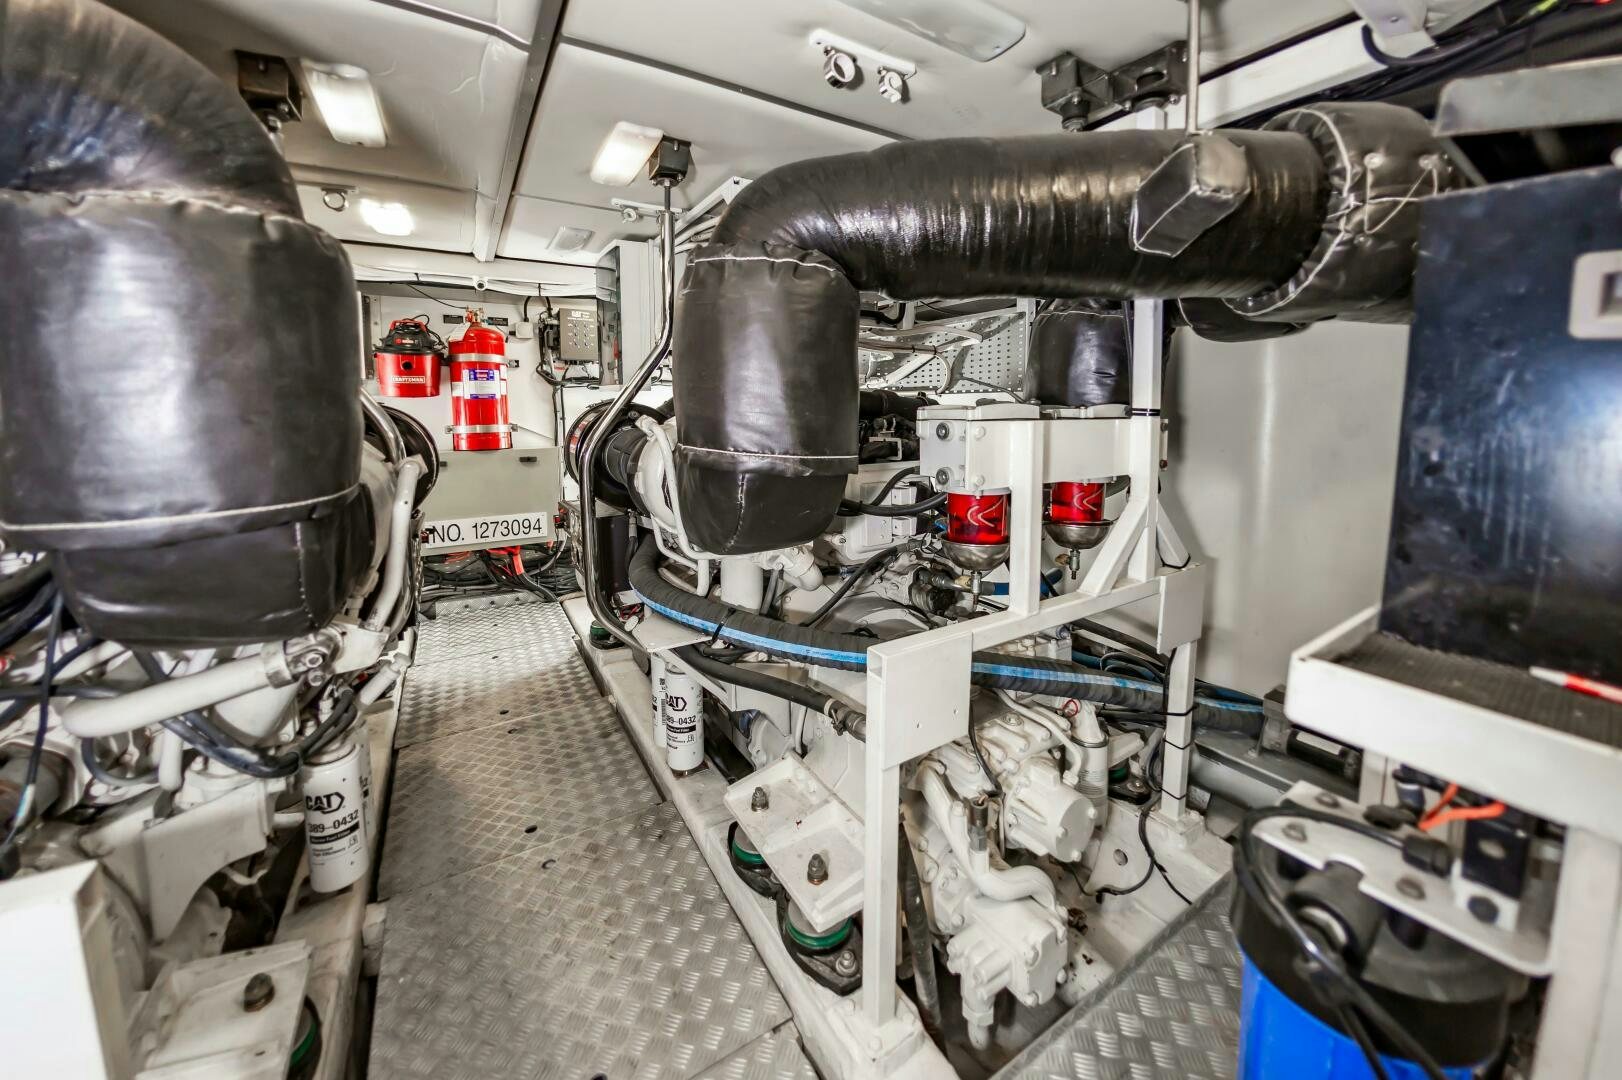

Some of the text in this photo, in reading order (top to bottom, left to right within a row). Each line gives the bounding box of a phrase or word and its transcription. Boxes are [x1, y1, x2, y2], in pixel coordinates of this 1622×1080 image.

[432, 518, 542, 543] NO. 1273094
[305, 792, 338, 812] CAT
[308, 809, 359, 833] 389-0432
